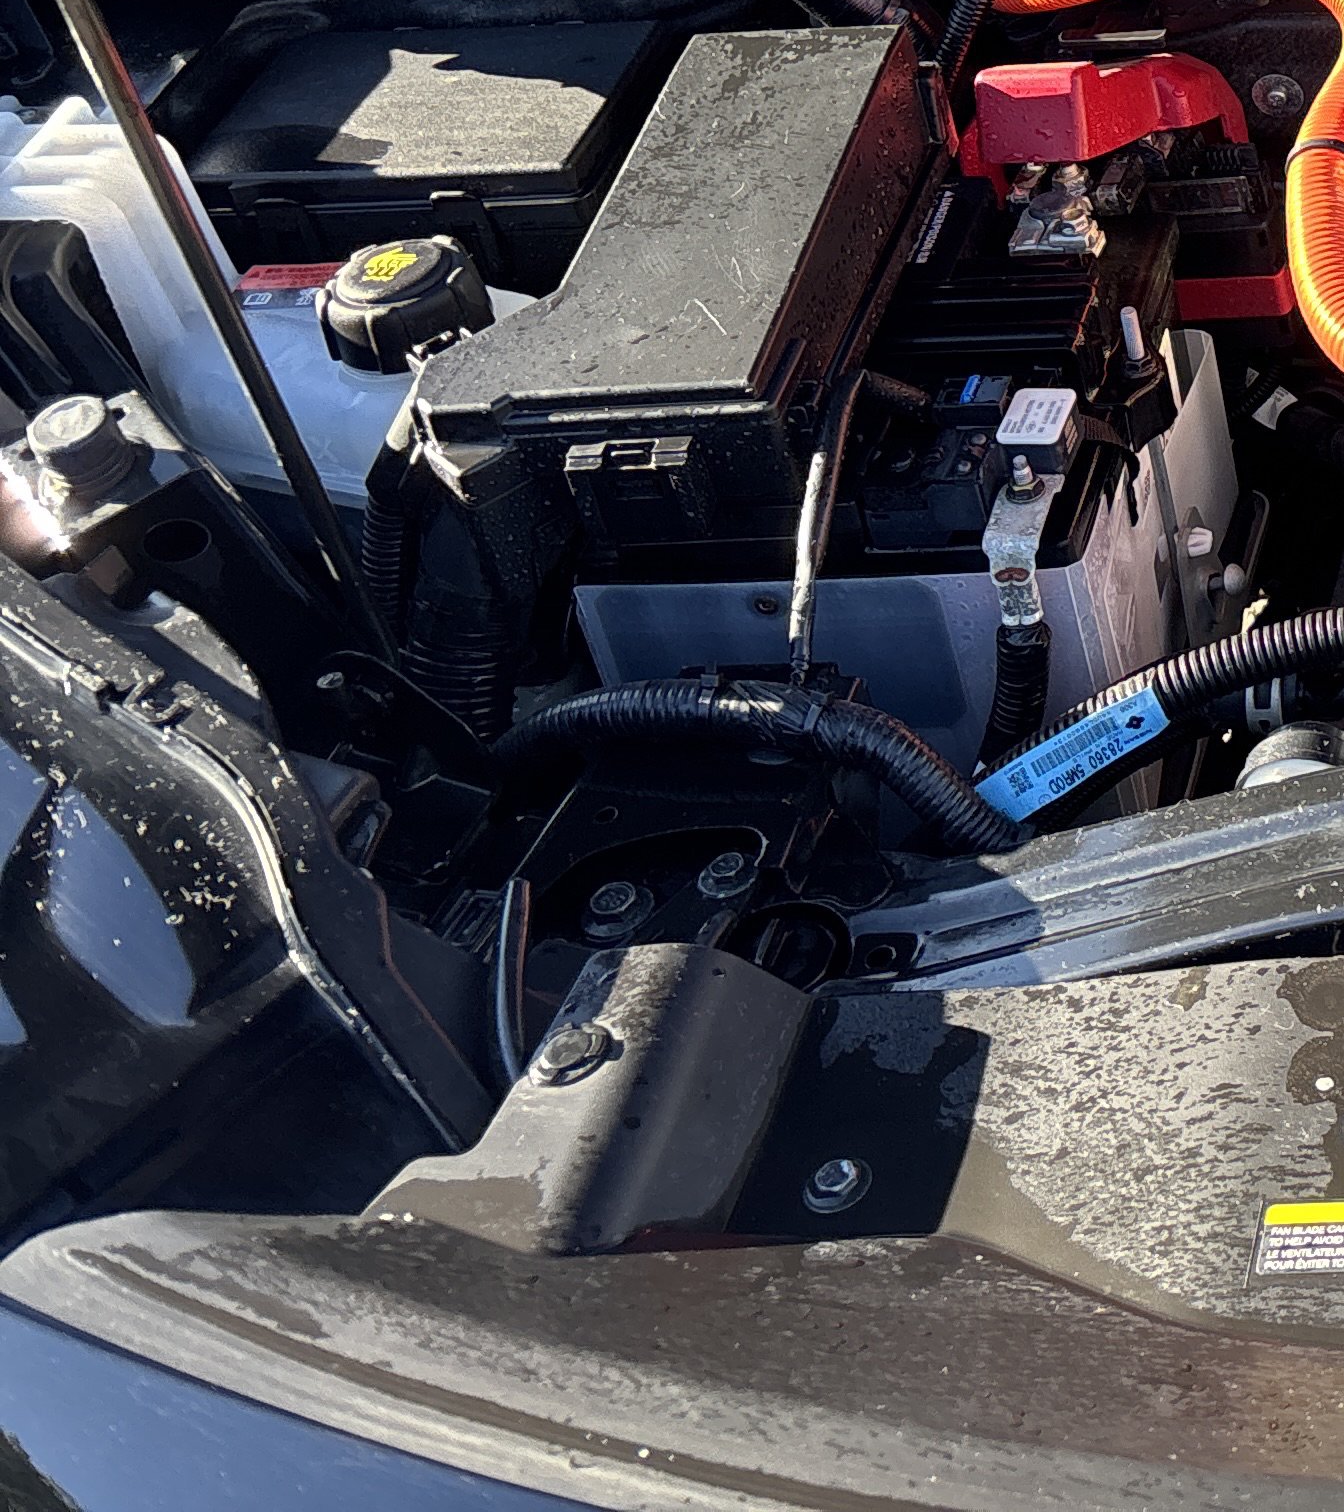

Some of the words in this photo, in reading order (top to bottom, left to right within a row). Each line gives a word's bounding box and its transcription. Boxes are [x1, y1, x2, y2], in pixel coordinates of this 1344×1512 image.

[1087, 737, 1124, 770] 28360
[1271, 1226, 1292, 1236] FAN
[1292, 1225, 1325, 1235] BLADE
[1269, 1237, 1283, 1247] TO
[1284, 1237, 1312, 1246] HELP
[1313, 1235, 1344, 1245] AVOID
[1265, 1250, 1279, 1259] LE
[1264, 1260, 1294, 1270] POUR
[1295, 1258, 1330, 1269] ÉVITER
